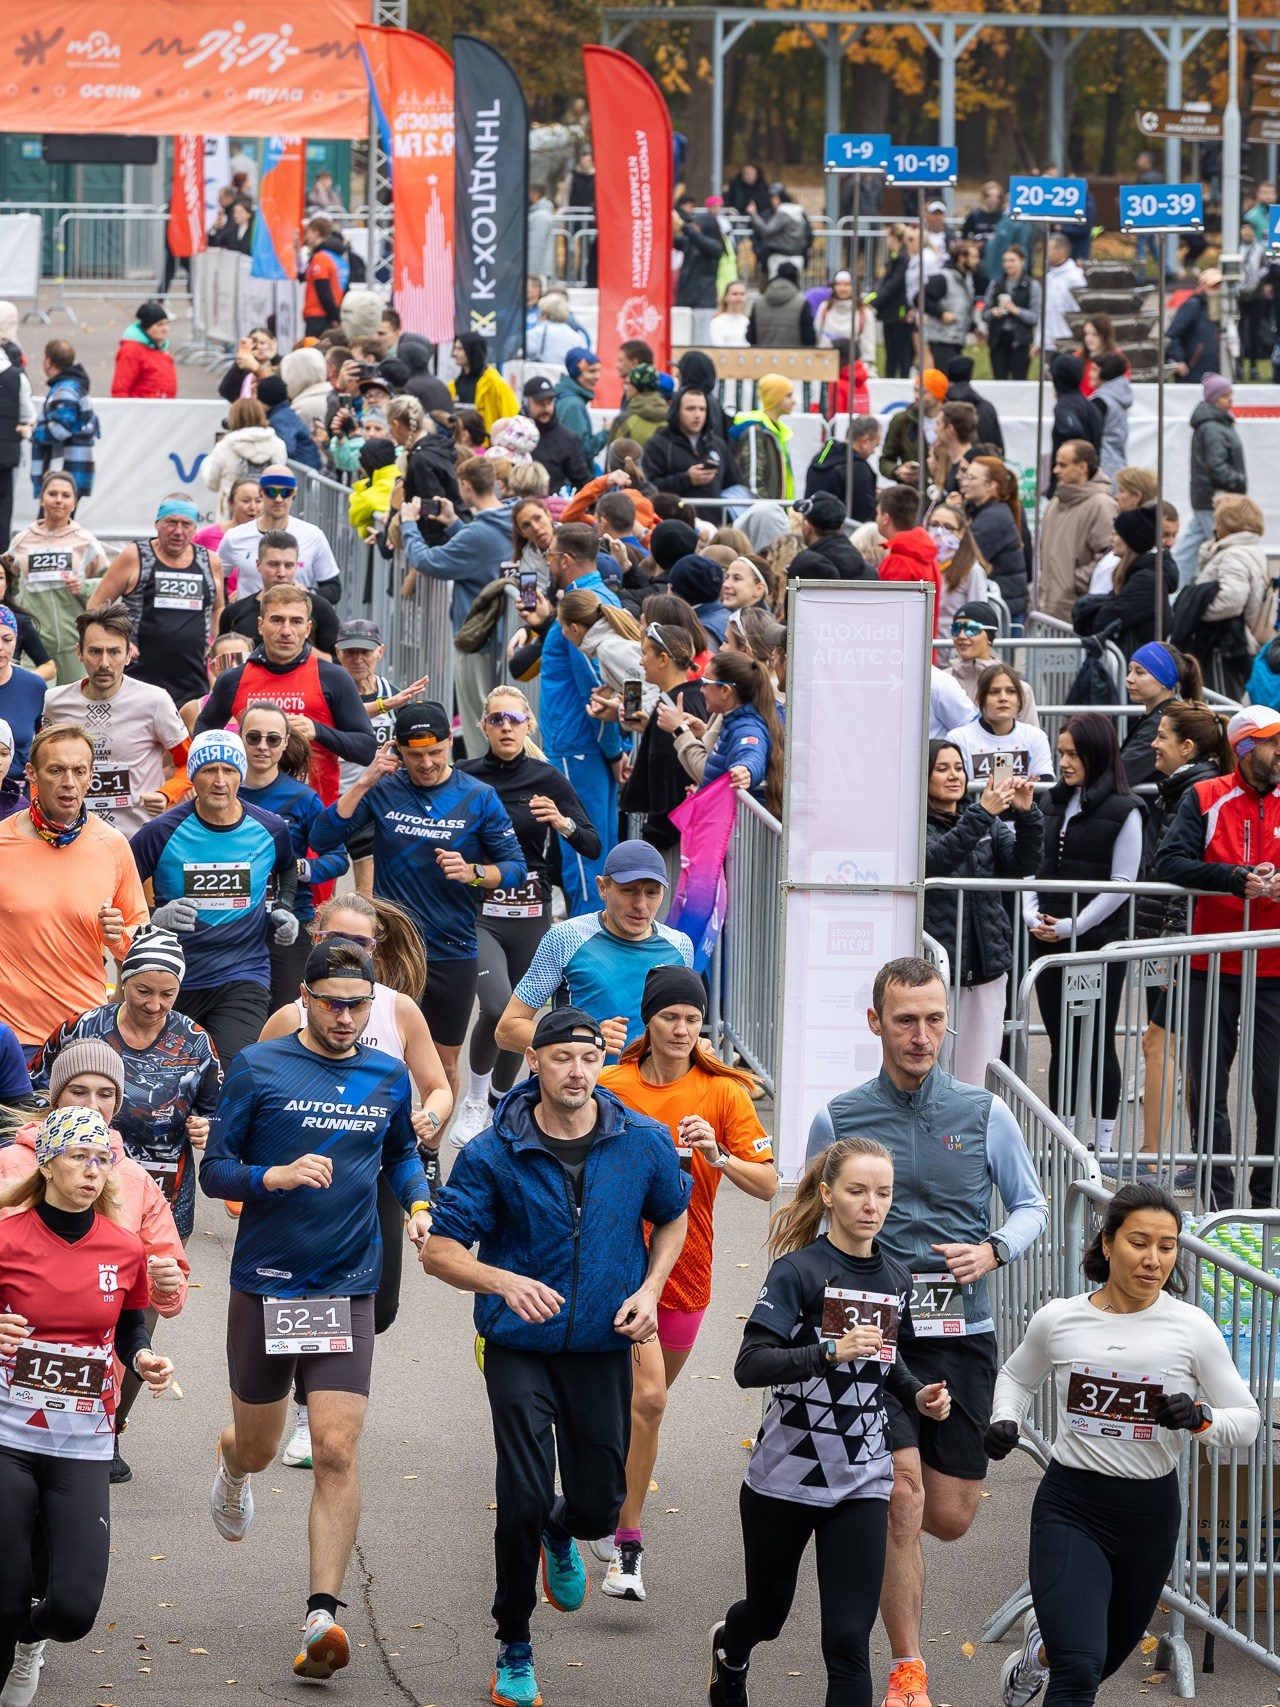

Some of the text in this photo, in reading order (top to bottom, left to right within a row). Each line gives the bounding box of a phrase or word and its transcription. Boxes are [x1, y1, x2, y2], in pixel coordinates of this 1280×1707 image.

[79, 84, 142, 99] осень
[246, 87, 304, 104] тула
[841, 140, 874, 160] 1-9
[892, 153, 950, 174] 10-19
[1015, 187, 1080, 208] 20-29
[1126, 194, 1196, 217] 30-39
[33, 554, 67, 568] 2215
[160, 580, 198, 597] 2230
[384, 810, 466, 829] AUTOCLASS
[394, 824, 452, 840] RUNNER
[193, 874, 242, 890] 2221
[283, 1100, 388, 1118] AUTOCLASS
[301, 1116, 377, 1132] RUNNER
[276, 1306, 341, 1334] 52-1
[843, 1306, 883, 1335] 3-1
[28, 1357, 91, 1387] 15-1
[1079, 1382, 1149, 1414] 37-1
